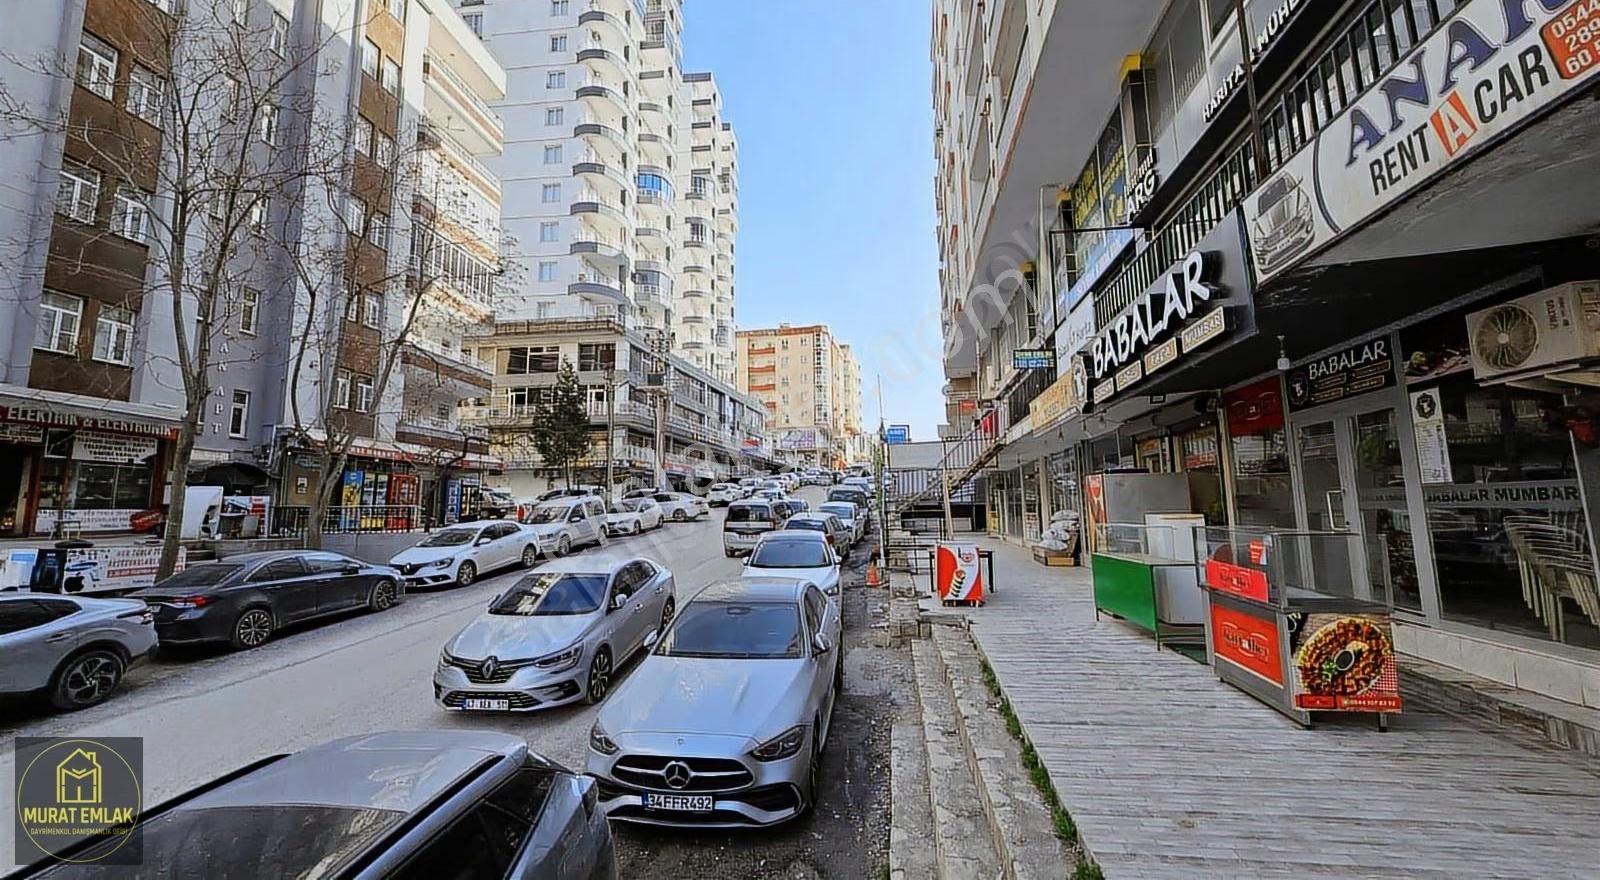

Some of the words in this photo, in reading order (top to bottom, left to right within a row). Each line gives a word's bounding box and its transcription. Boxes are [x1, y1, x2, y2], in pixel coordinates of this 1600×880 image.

[1565, 48, 1593, 75] 60
[1369, 122, 1431, 196] RENT
[1473, 44, 1550, 125] CAR
[1092, 250, 1210, 379] BABALAR
[1308, 340, 1387, 381] BABALAR
[1494, 485, 1579, 502] MUMBAR
[648, 794, 712, 810] 34FFR492
